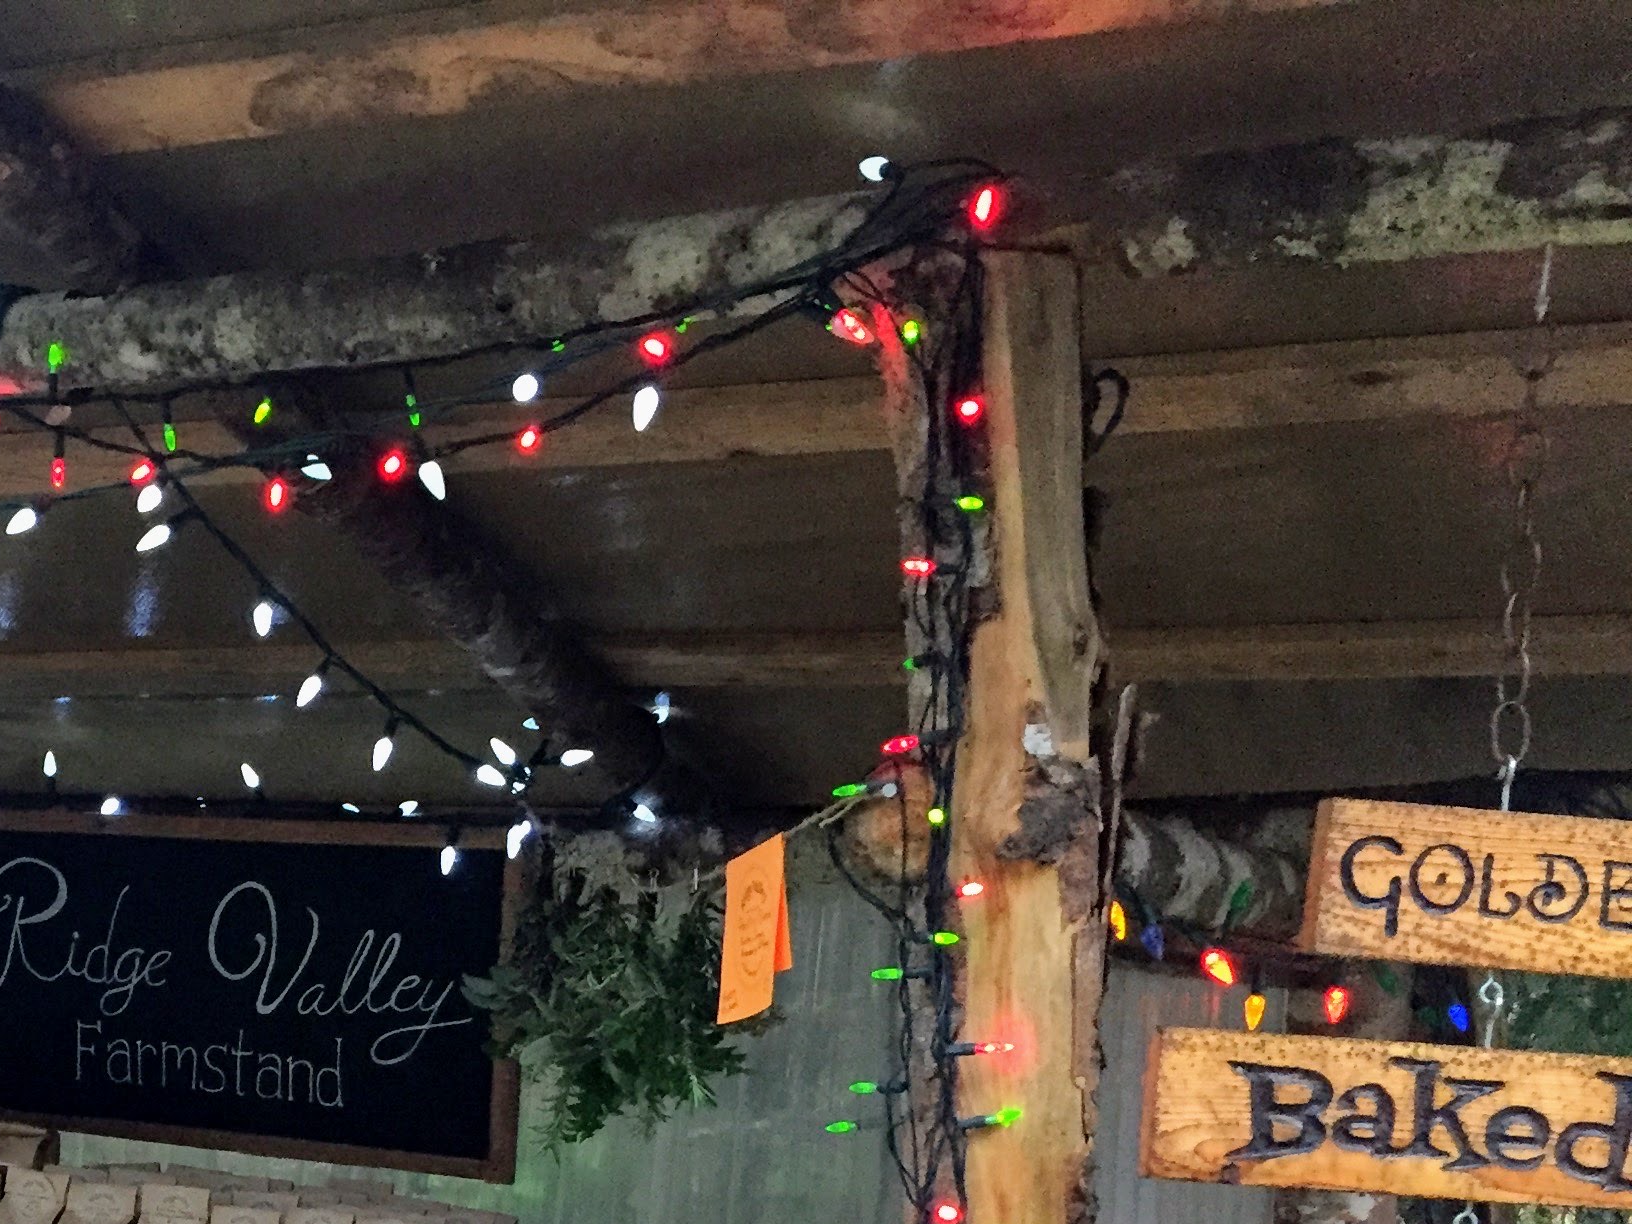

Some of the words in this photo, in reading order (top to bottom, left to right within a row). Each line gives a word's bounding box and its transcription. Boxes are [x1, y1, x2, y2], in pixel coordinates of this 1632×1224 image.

[208, 881, 473, 1066] Valley
[74, 1019, 345, 1108] Farmstand
[1225, 1056, 1632, 1193] Baked
